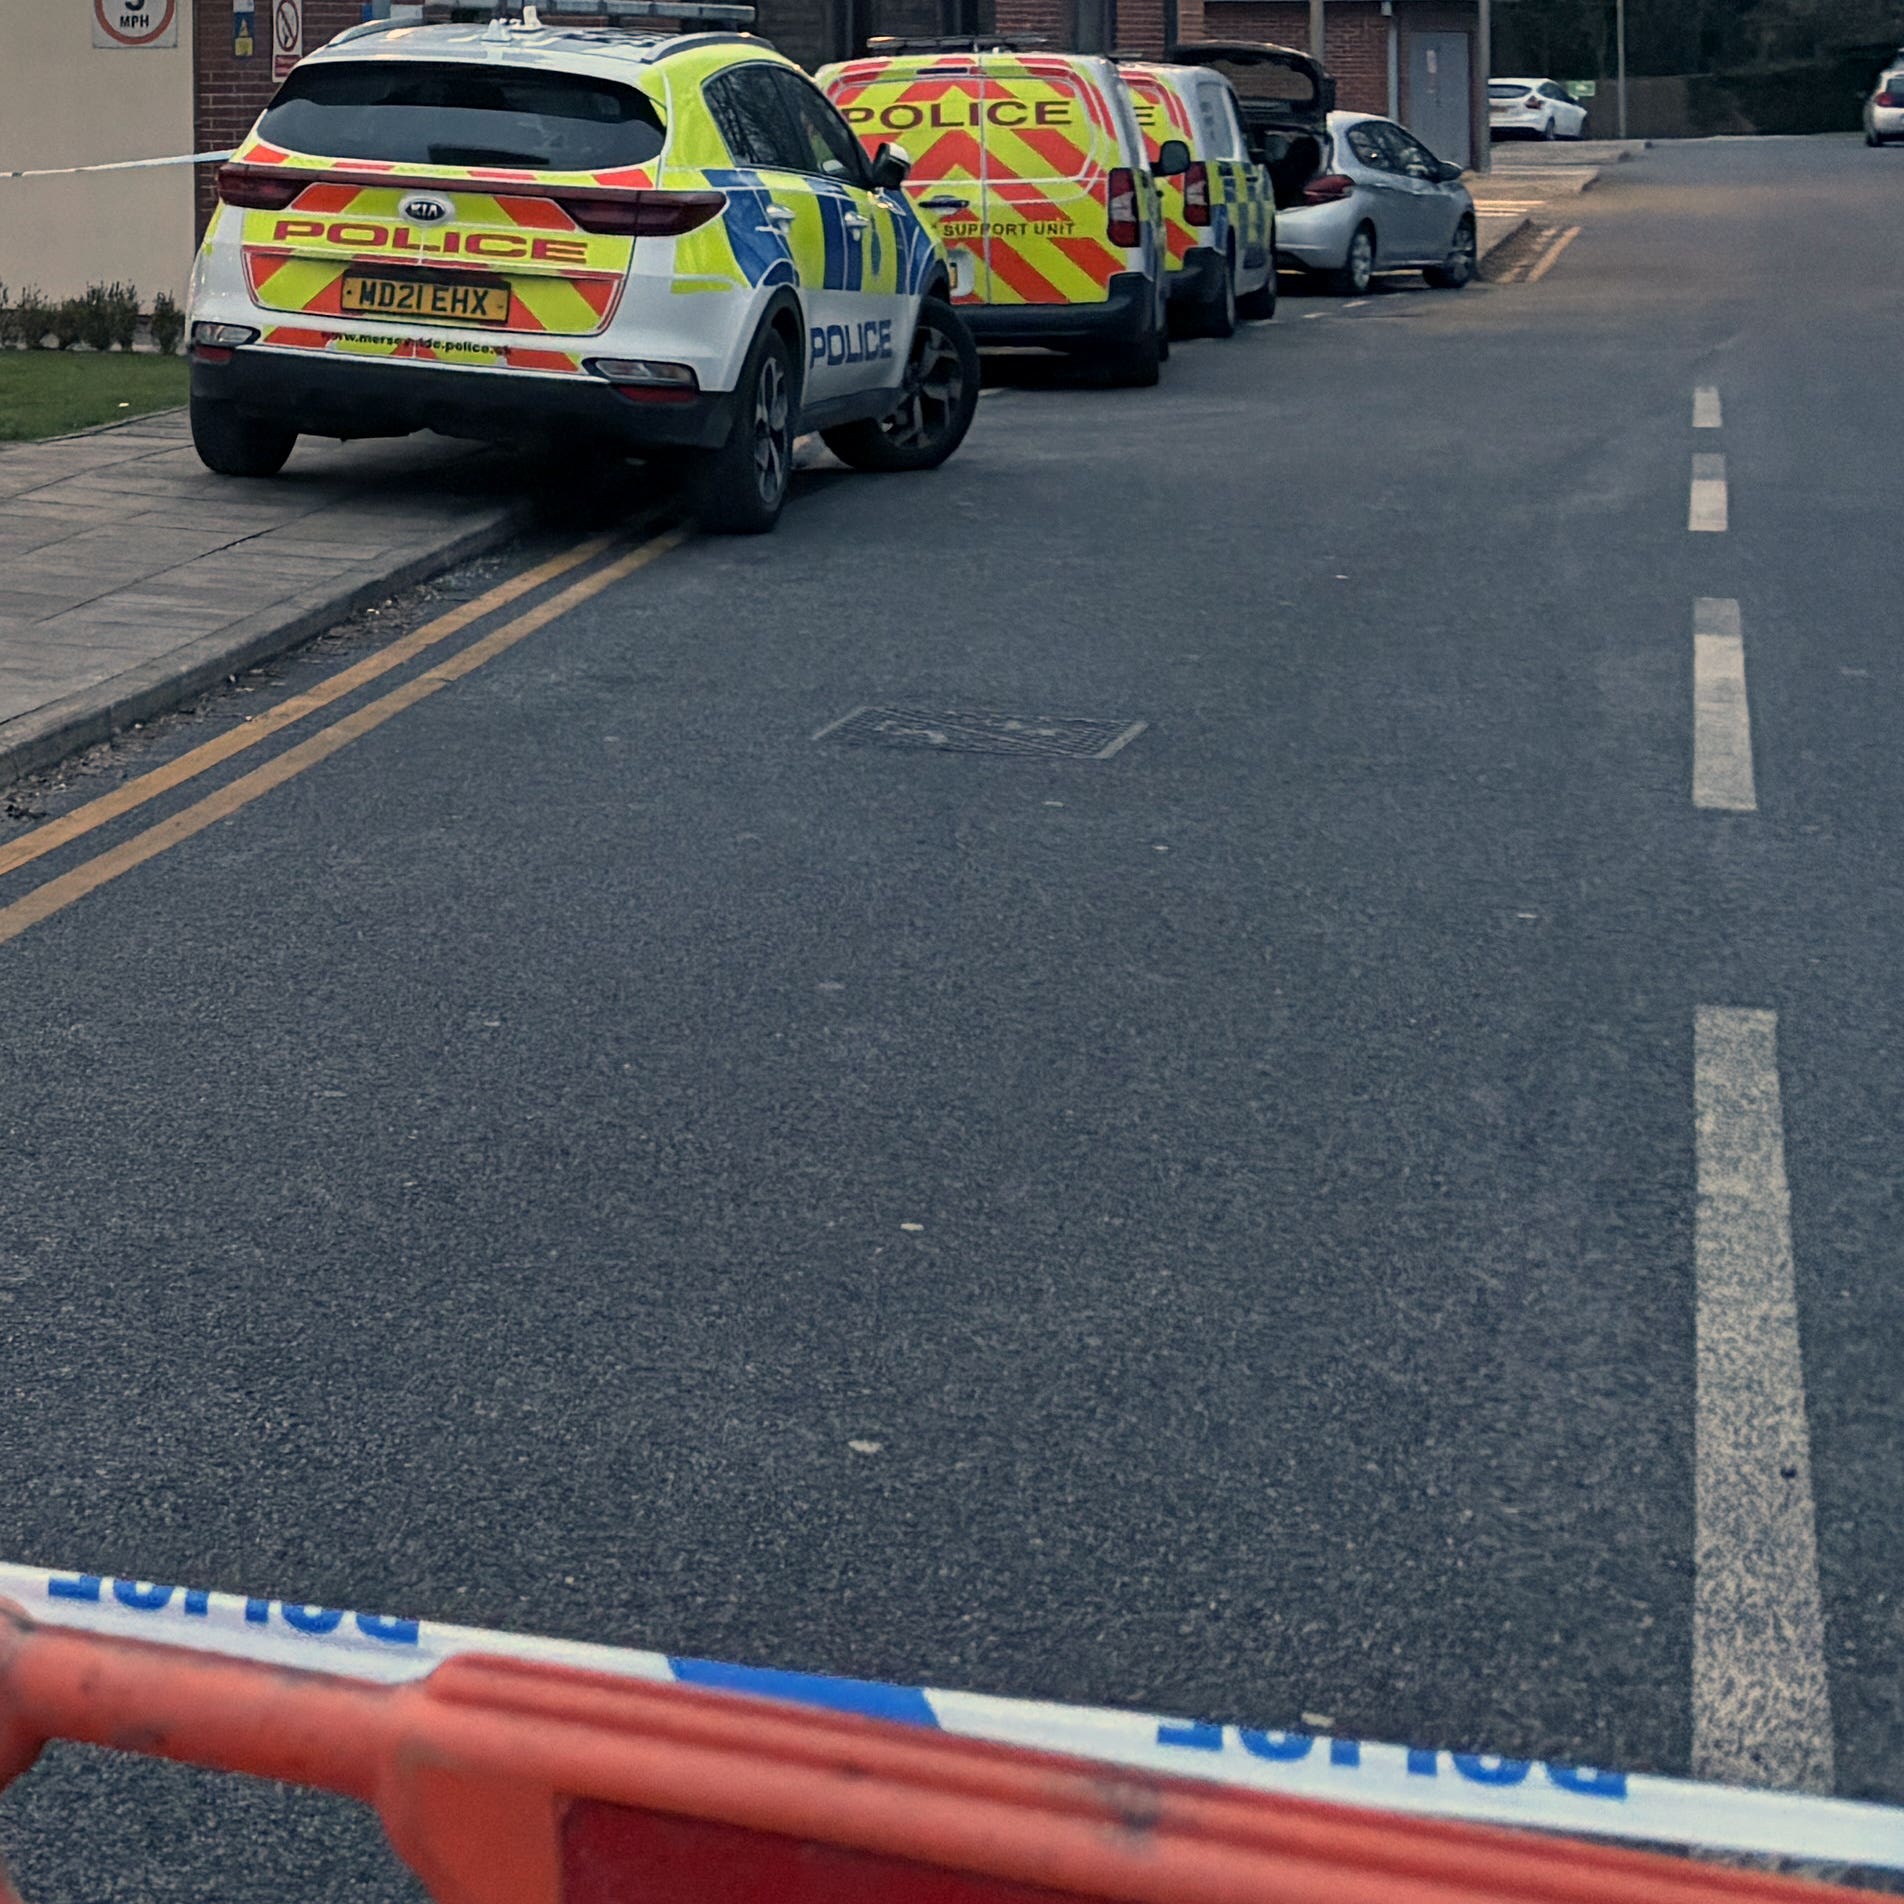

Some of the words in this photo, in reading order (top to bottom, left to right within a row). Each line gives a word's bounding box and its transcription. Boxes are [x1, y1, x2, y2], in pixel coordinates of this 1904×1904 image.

[119, 15, 150, 29] MPH
[839, 99, 1072, 130] POLICE
[409, 201, 440, 219] KIA
[272, 219, 589, 264] POLICE
[943, 222, 1027, 237] SUPPORT
[1034, 222, 1075, 236] UNIT
[359, 280, 423, 314] MD21
[429, 285, 489, 317] EHX
[808, 318, 895, 369] POLICE
